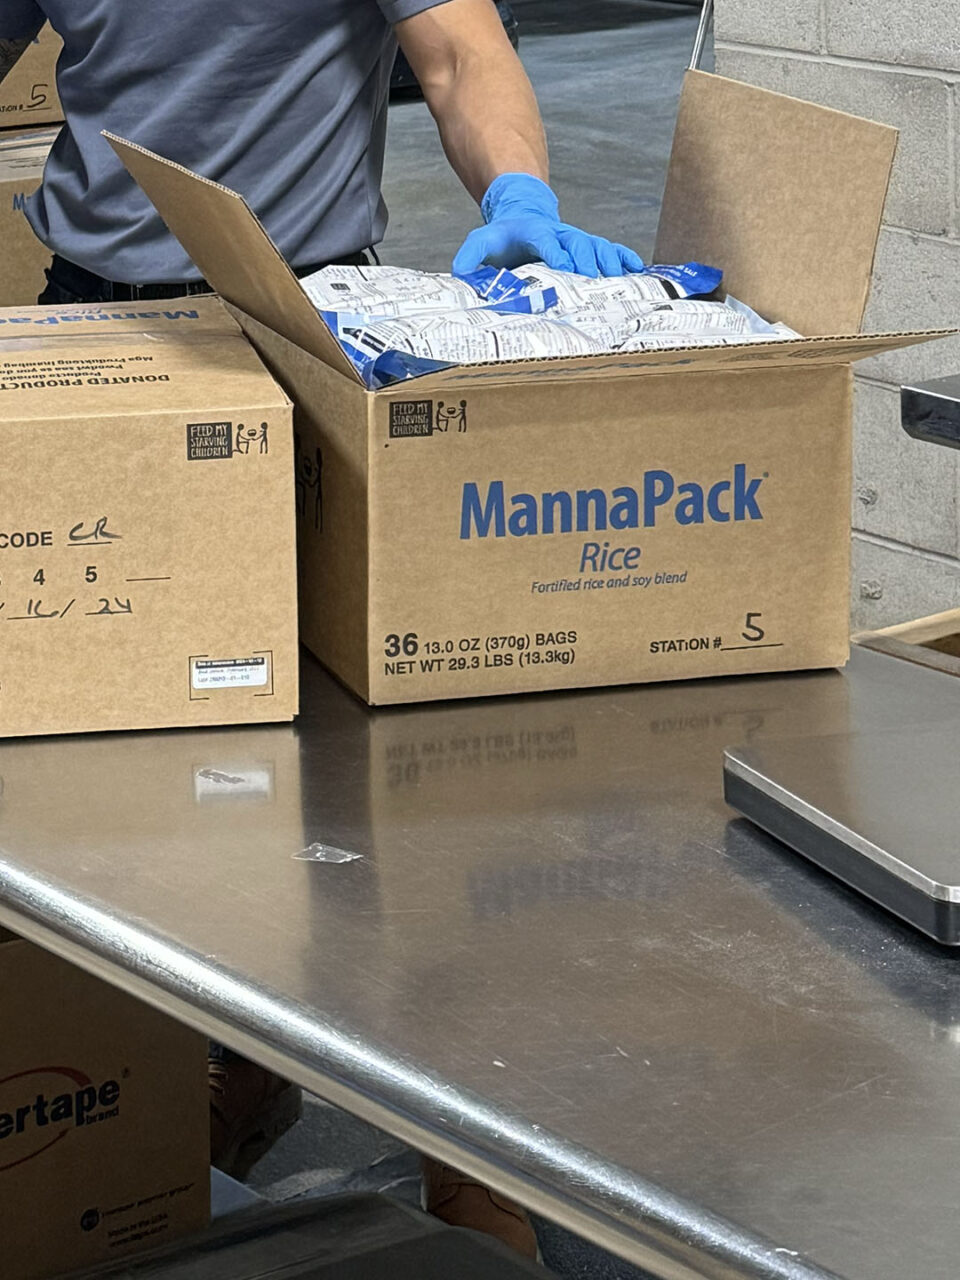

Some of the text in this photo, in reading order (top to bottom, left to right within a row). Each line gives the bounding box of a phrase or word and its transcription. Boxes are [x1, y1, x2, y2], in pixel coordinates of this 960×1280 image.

[26, 84, 49, 108] 5
[0, 379, 83, 390] PRODUCT
[88, 375, 170, 385] DONATED
[393, 402, 428, 415] FEED MY
[392, 414, 429, 426] STARVING
[190, 424, 228, 437] FEED MY
[392, 424, 429, 436] CHILDREN
[190, 436, 228, 447] STARVING
[191, 447, 228, 458] CHILDREN
[460, 463, 764, 539] MannaPack
[579, 542, 641, 573] Rice
[33, 569, 46, 586] 4
[85, 566, 98, 583] 5
[531, 571, 688, 594] Fortified rice and soy blend
[741, 612, 764, 642] 5
[384, 631, 577, 658] 36 13.0 OZ (370g) BAGS
[649, 636, 722, 653] STATION #
[384, 648, 576, 676] NET WT 29.3 LBS (13.3kg)
[85, 1105, 120, 1125] brand
